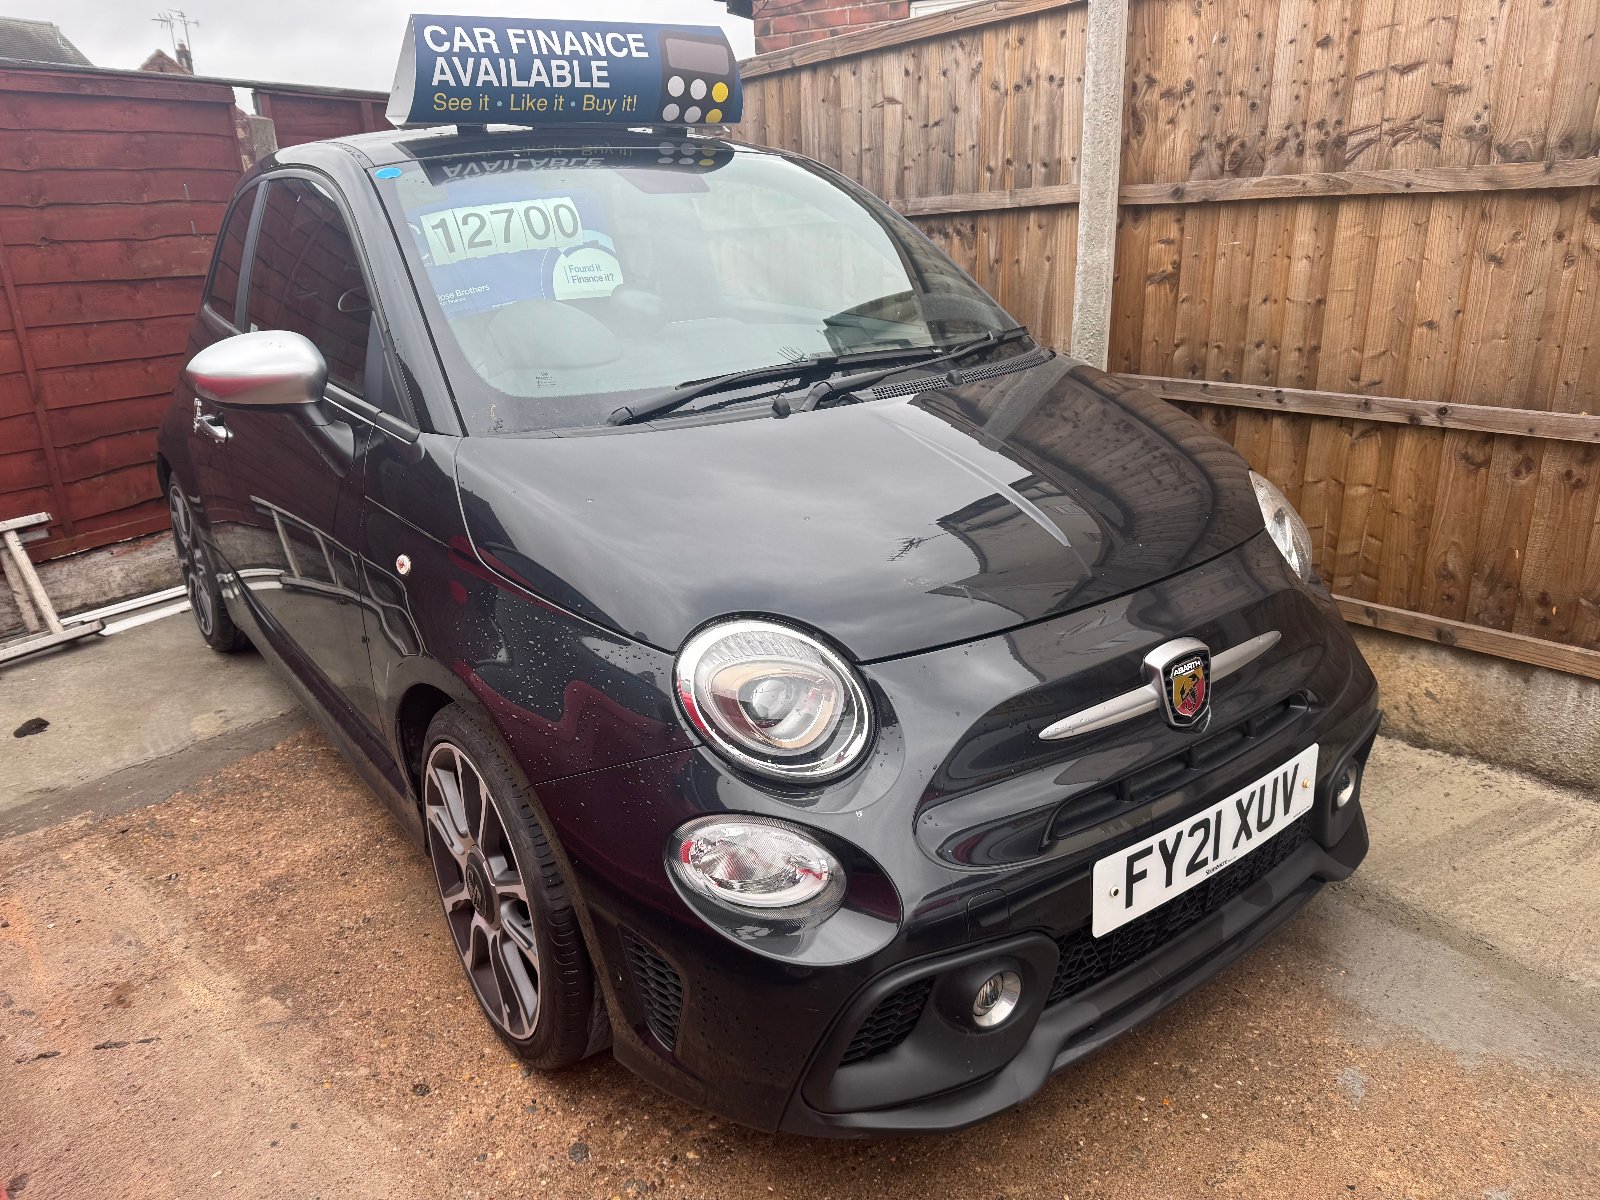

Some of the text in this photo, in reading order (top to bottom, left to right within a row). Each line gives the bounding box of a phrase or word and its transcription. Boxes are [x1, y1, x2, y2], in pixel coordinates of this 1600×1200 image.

[423, 25, 649, 58] CAR FINANCE
[431, 56, 610, 88] AVAILABLE
[433, 92, 637, 115] See it Like it Buy it!
[431, 203, 579, 254] 12700
[568, 263, 603, 273] Found it
[571, 272, 615, 284] Finance it?
[436, 284, 490, 302] lose Brothers
[1173, 660, 1201, 676] ABARTH
[1125, 763, 1300, 909] FY21 XUV
